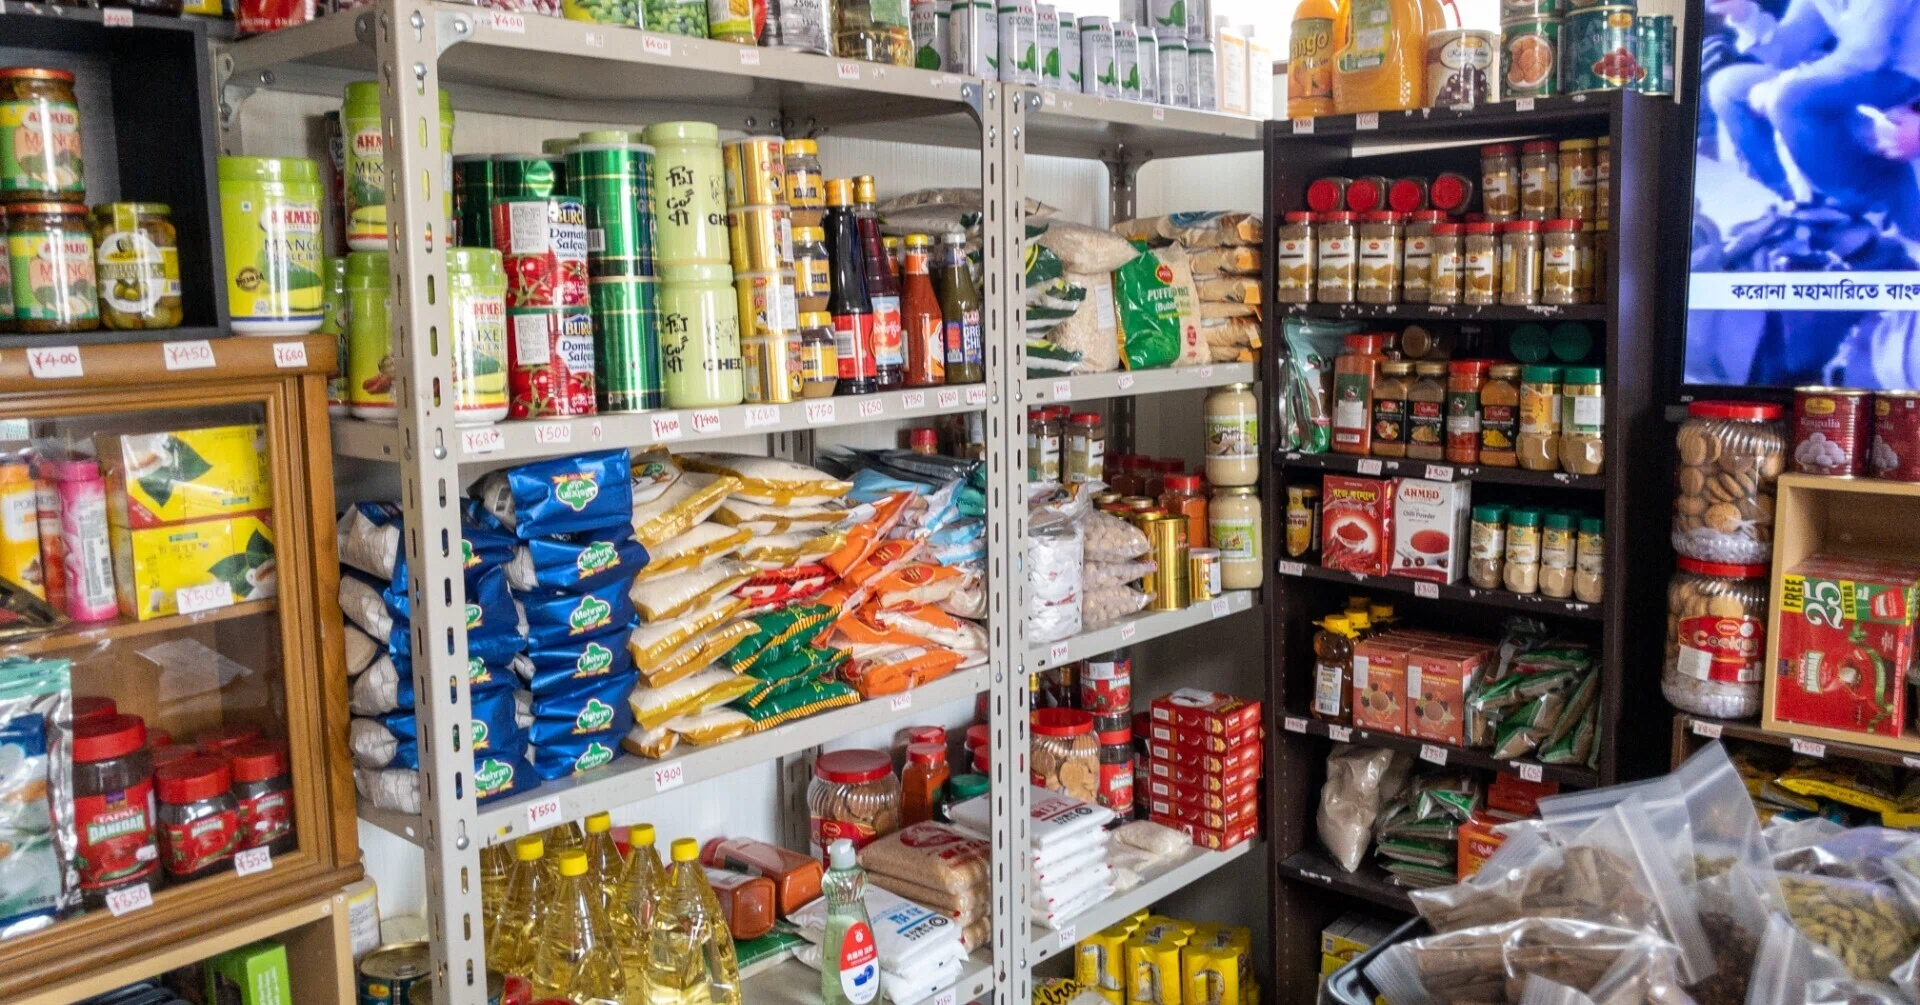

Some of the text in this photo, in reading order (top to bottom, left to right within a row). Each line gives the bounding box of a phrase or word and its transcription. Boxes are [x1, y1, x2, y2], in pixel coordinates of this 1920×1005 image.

[29, 112, 75, 125] AMED
[44, 243, 89, 255] AMED
[1731, 284, 1786, 300] করোনা
[1792, 279, 1879, 301] মহামারিতে
[168, 346, 210, 366] ¥450
[537, 426, 570, 444] ¥500
[1404, 488, 1440, 501] AHMED
[181, 584, 225, 608] ¥500
[1784, 578, 1803, 608] FREE
[1843, 584, 1856, 614] EXTRA
[1803, 581, 1844, 630] 25
[655, 767, 682, 786] ¥900
[530, 802, 557, 822] ¥550
[89, 812, 145, 843] DANEDAR
